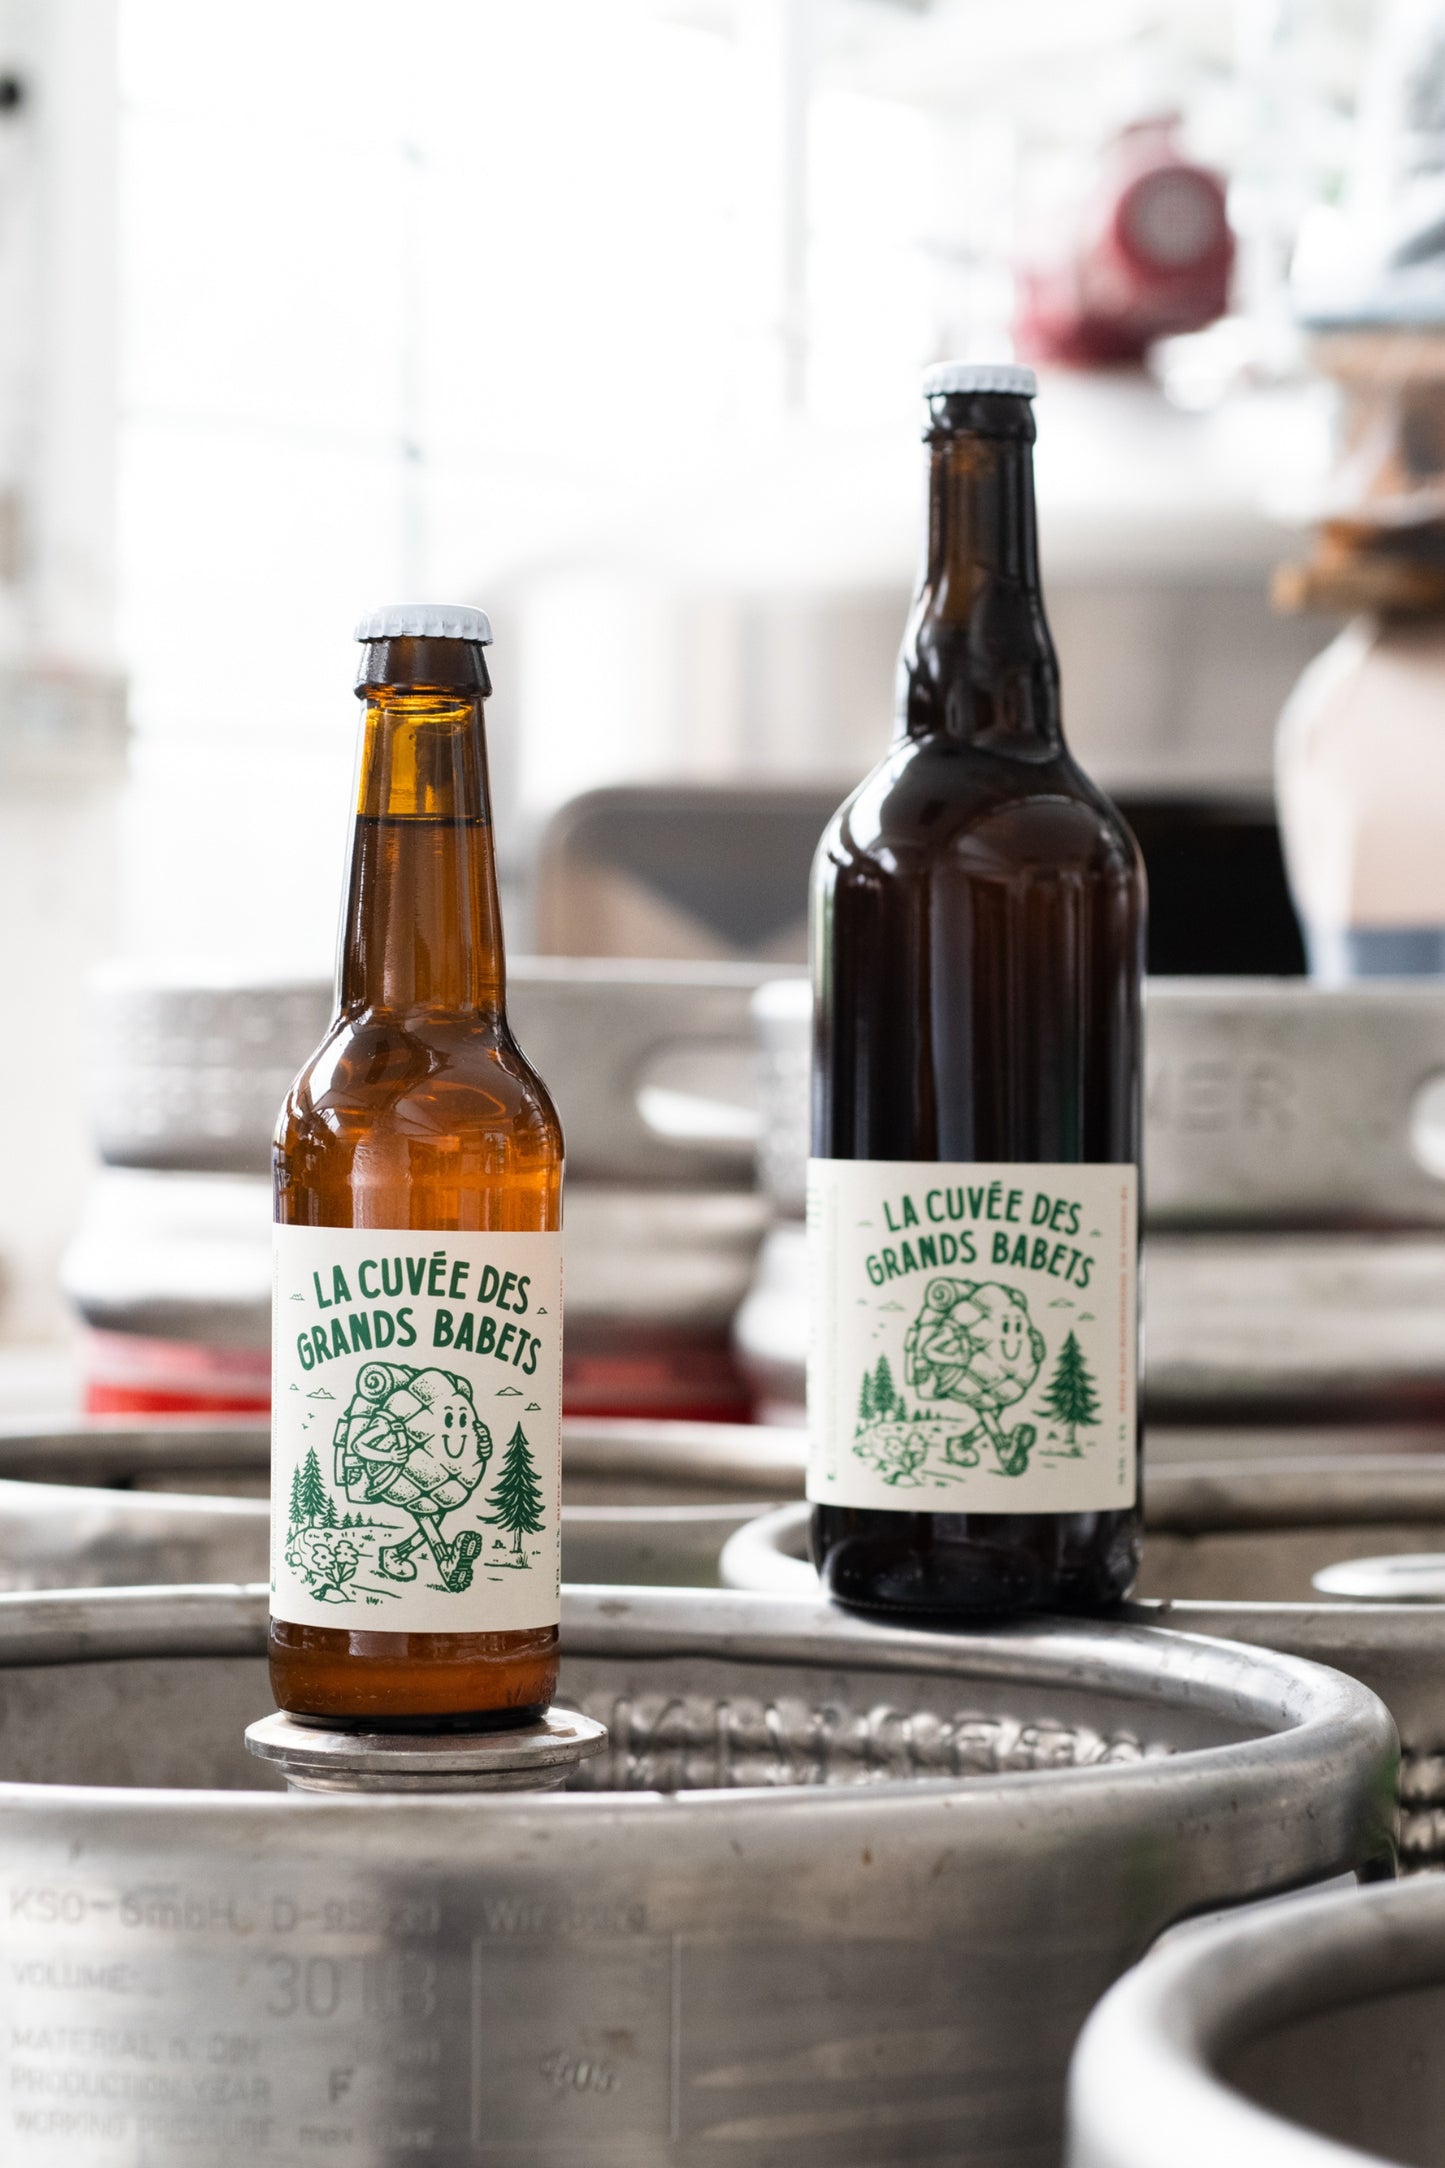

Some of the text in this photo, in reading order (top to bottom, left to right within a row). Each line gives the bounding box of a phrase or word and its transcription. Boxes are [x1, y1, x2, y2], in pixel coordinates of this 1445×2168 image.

[884, 1180, 1084, 1238] LA CUVÉE DES
[313, 1250, 531, 1315] LA CUVÉE DES
[866, 1230, 1096, 1290] GRANDS BABETS
[297, 1308, 542, 1376] GRANDS BABETS
